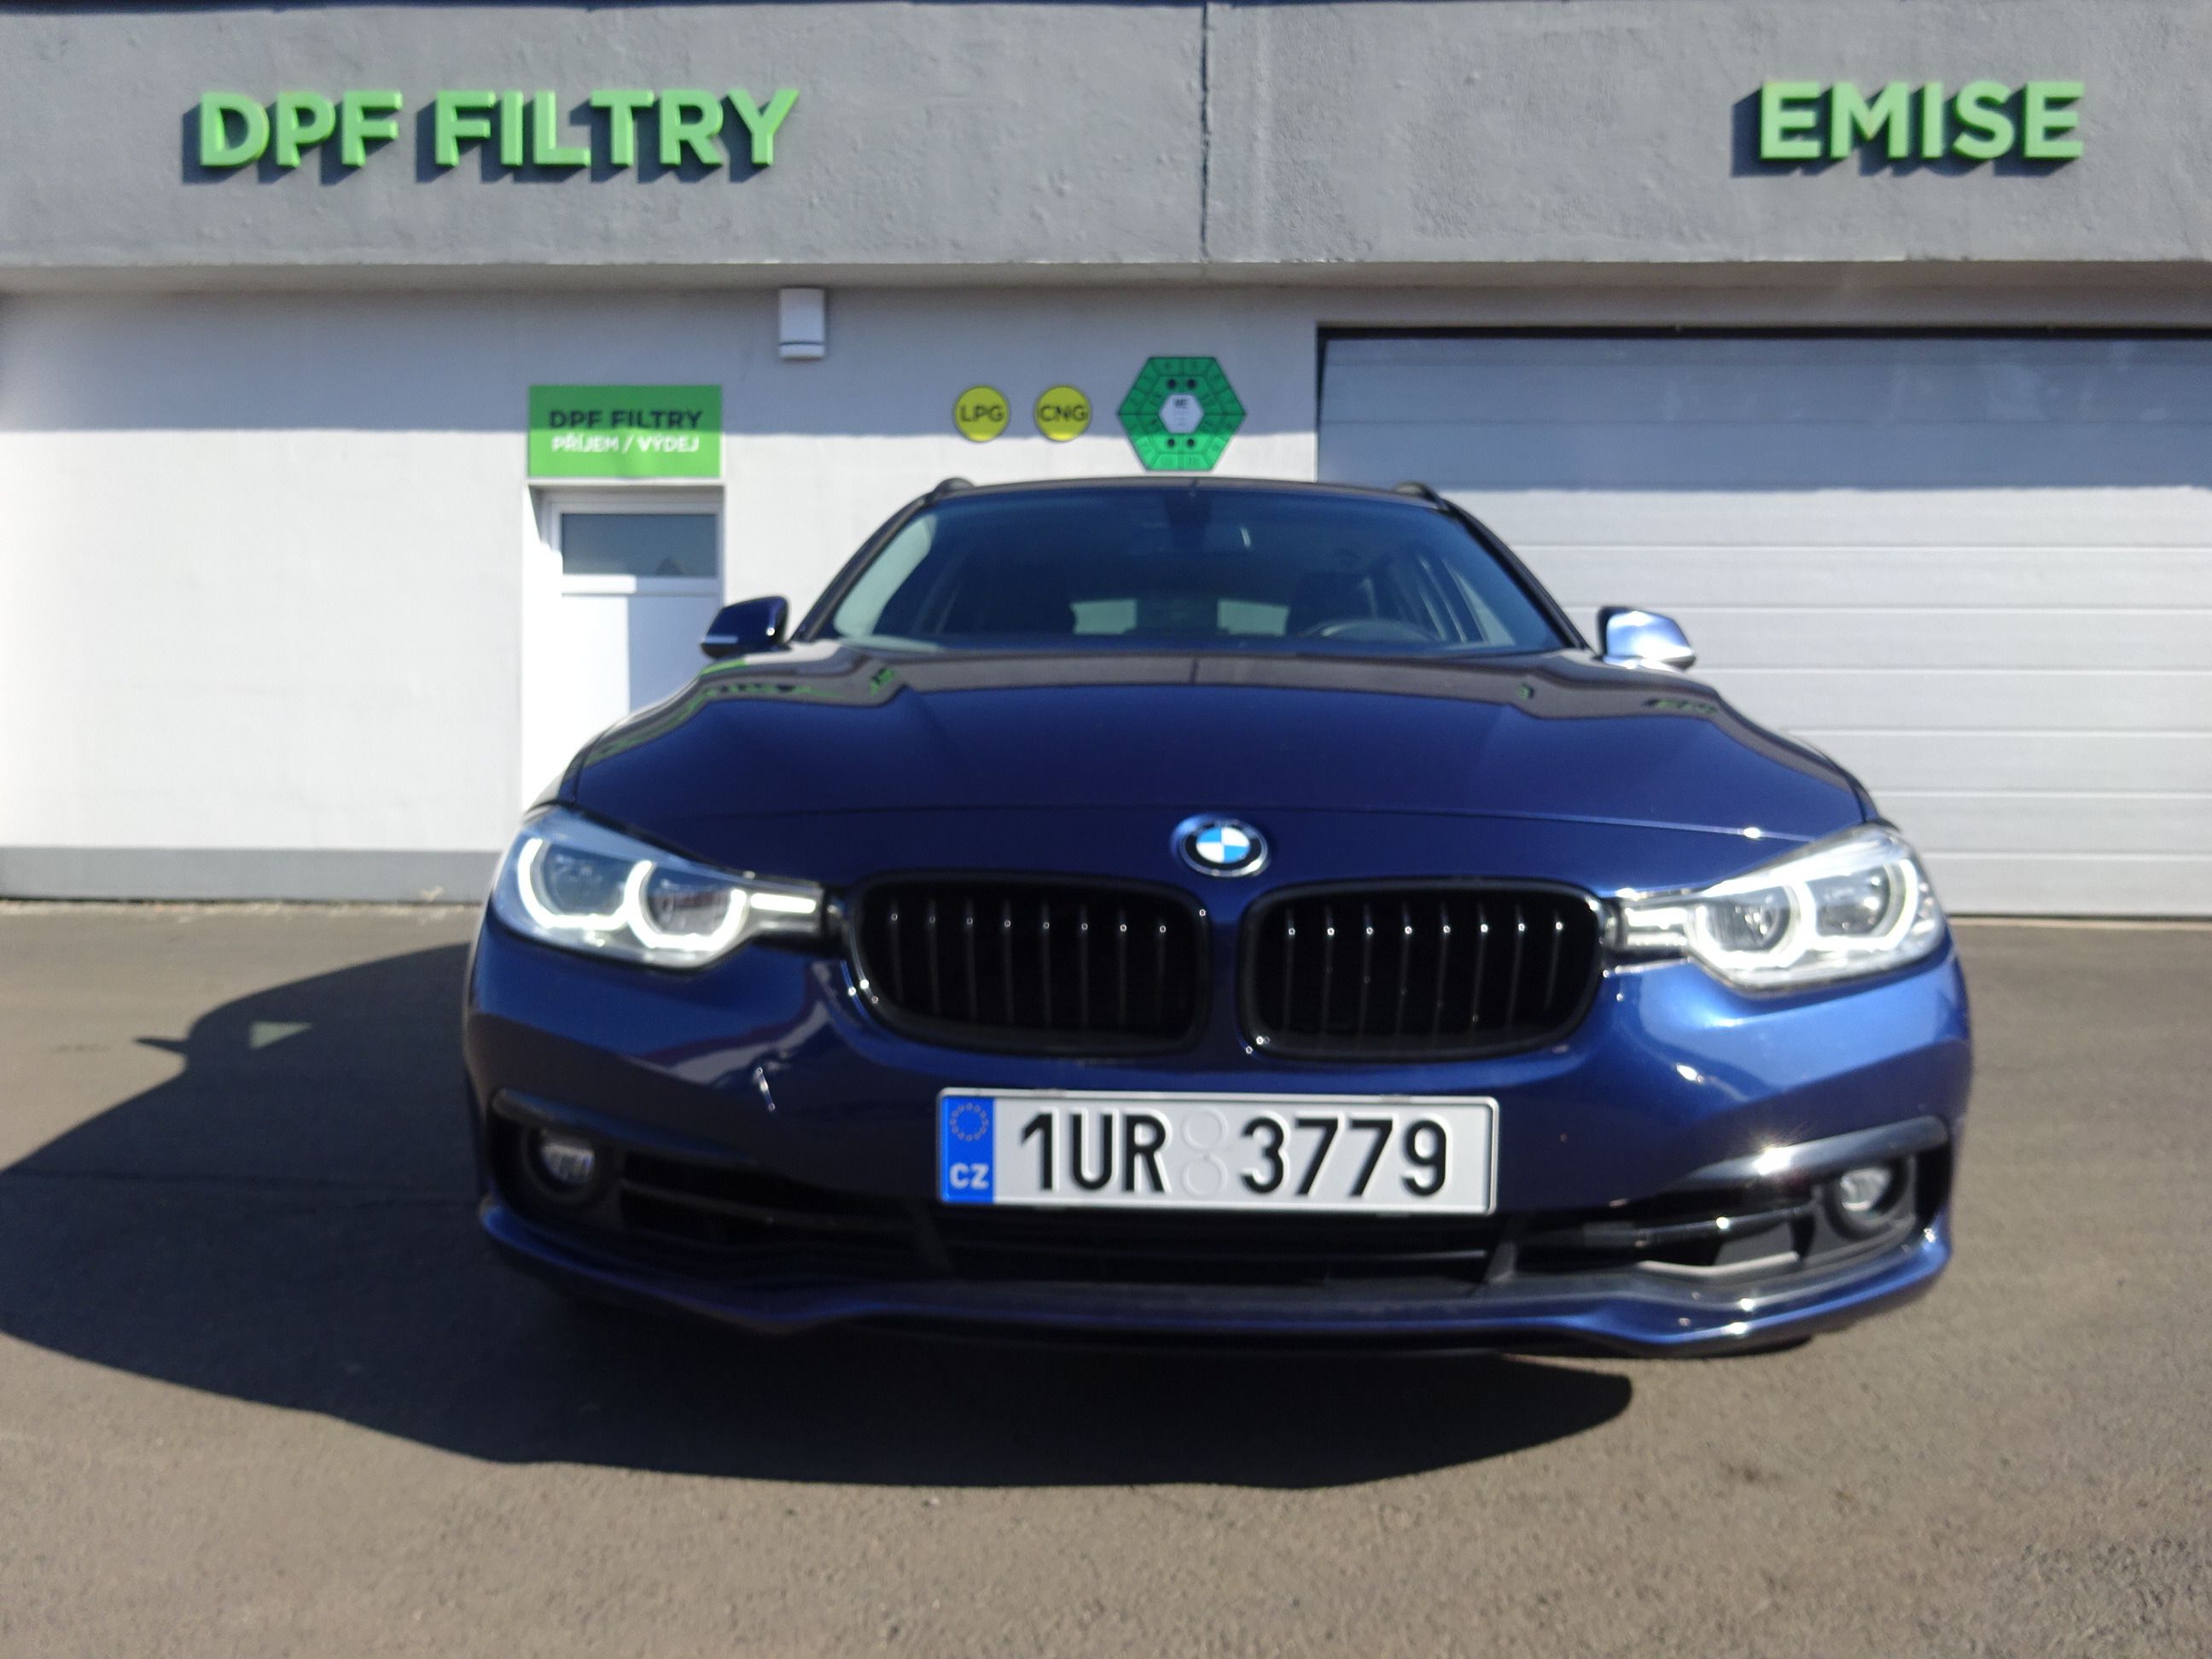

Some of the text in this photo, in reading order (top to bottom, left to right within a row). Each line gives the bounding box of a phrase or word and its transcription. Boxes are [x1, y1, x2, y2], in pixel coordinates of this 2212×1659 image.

[200, 90, 799, 166] DPF FILTRY
[1759, 81, 2085, 160] EMISE
[550, 409, 703, 428] DPF FILTRY
[960, 405, 1004, 422] LPG
[1039, 405, 1090, 422] CNG
[551, 432, 620, 452] PŘÍJEM
[637, 433, 700, 452] VÝDEJ
[1021, 1112, 1447, 1197] 1UR 3779
[949, 1162, 990, 1190] CZ
